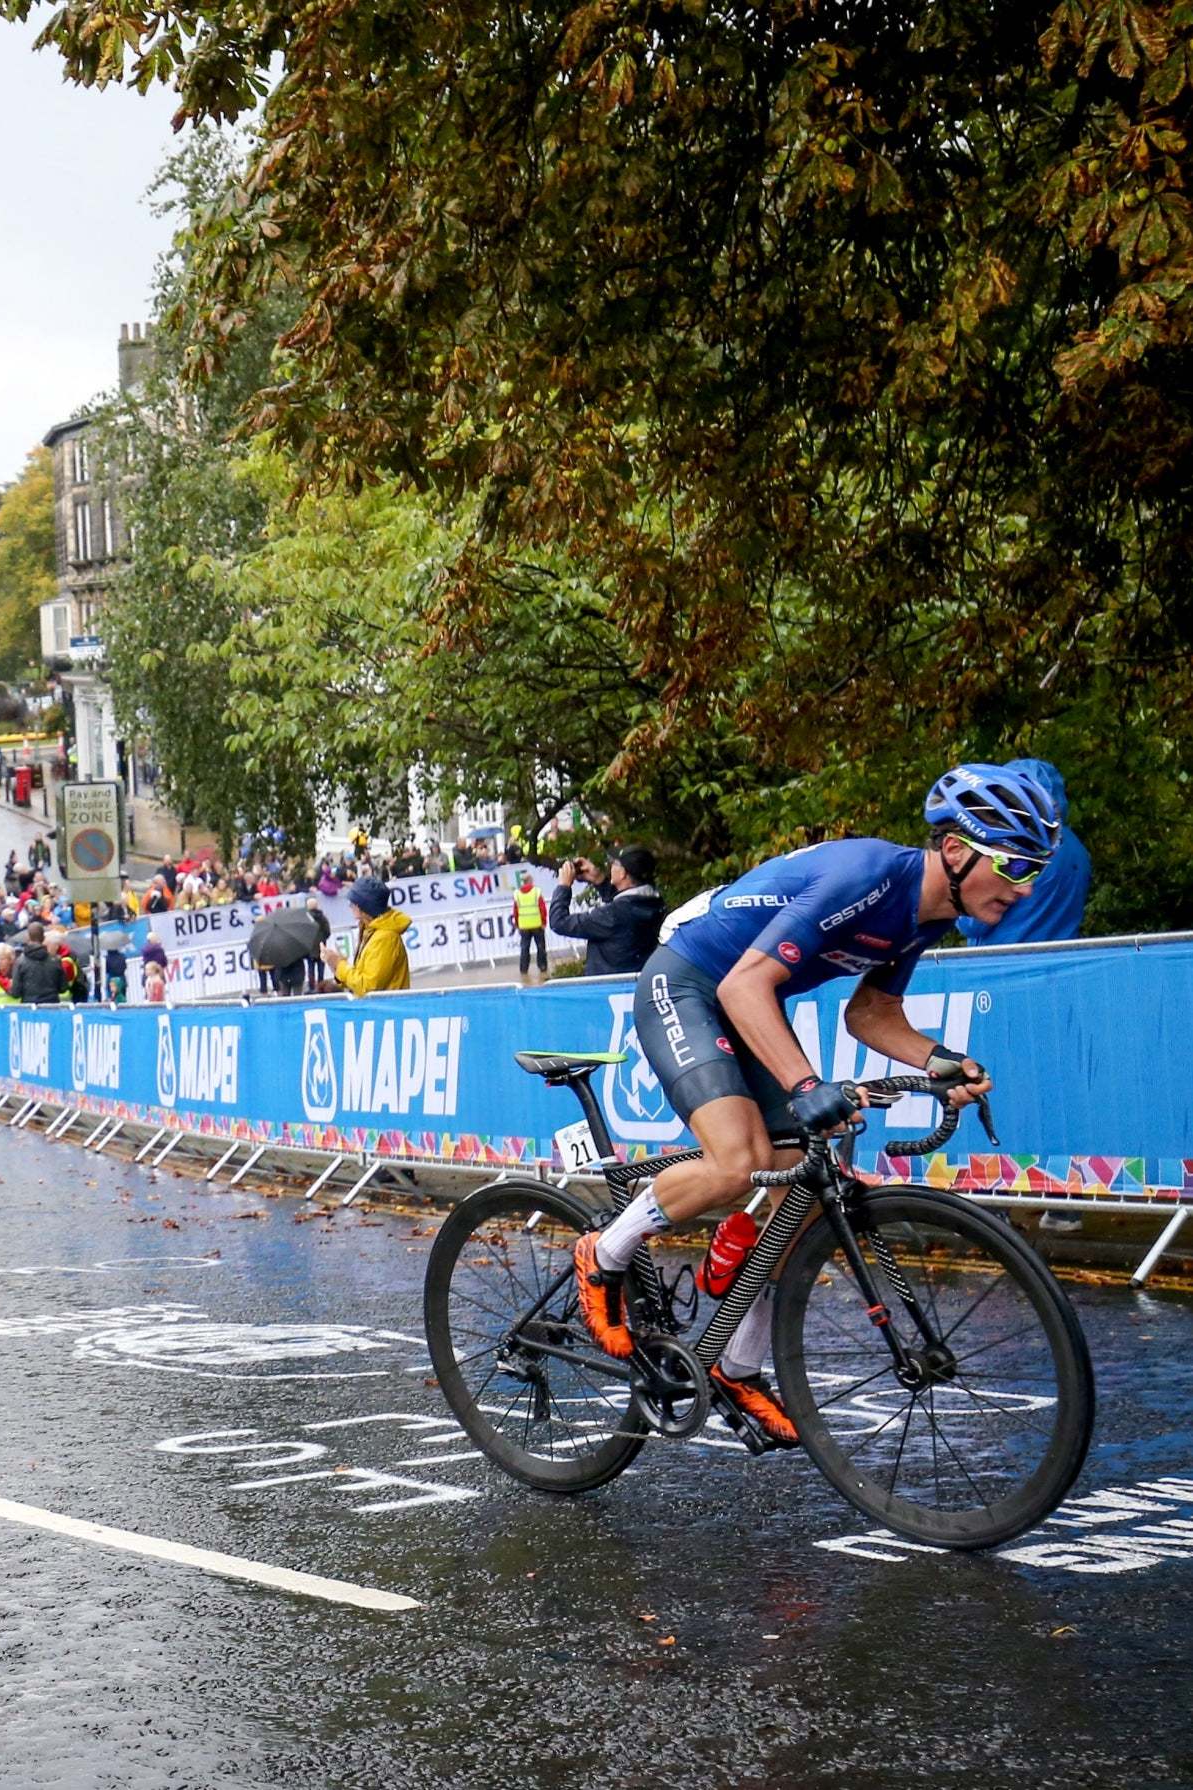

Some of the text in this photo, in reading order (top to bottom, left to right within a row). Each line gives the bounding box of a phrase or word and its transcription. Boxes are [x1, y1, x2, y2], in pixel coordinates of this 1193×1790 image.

[69, 789, 111, 799] Pay and
[70, 800, 110, 809] Display
[70, 811, 113, 824] ZONE
[957, 812, 987, 839] ITALIA
[391, 884, 422, 906] DE
[430, 881, 447, 901] &
[819, 878, 891, 932] CASTELLI
[174, 911, 223, 937] RIDE
[229, 908, 244, 928] &
[651, 973, 696, 1068] CASTELLI
[22, 1021, 50, 1078] MAPEI
[88, 1023, 122, 1089] MAPEI
[179, 1025, 240, 1104] MAPEI
[342, 1016, 462, 1116] MAPEI
[570, 1139, 593, 1167] 21
